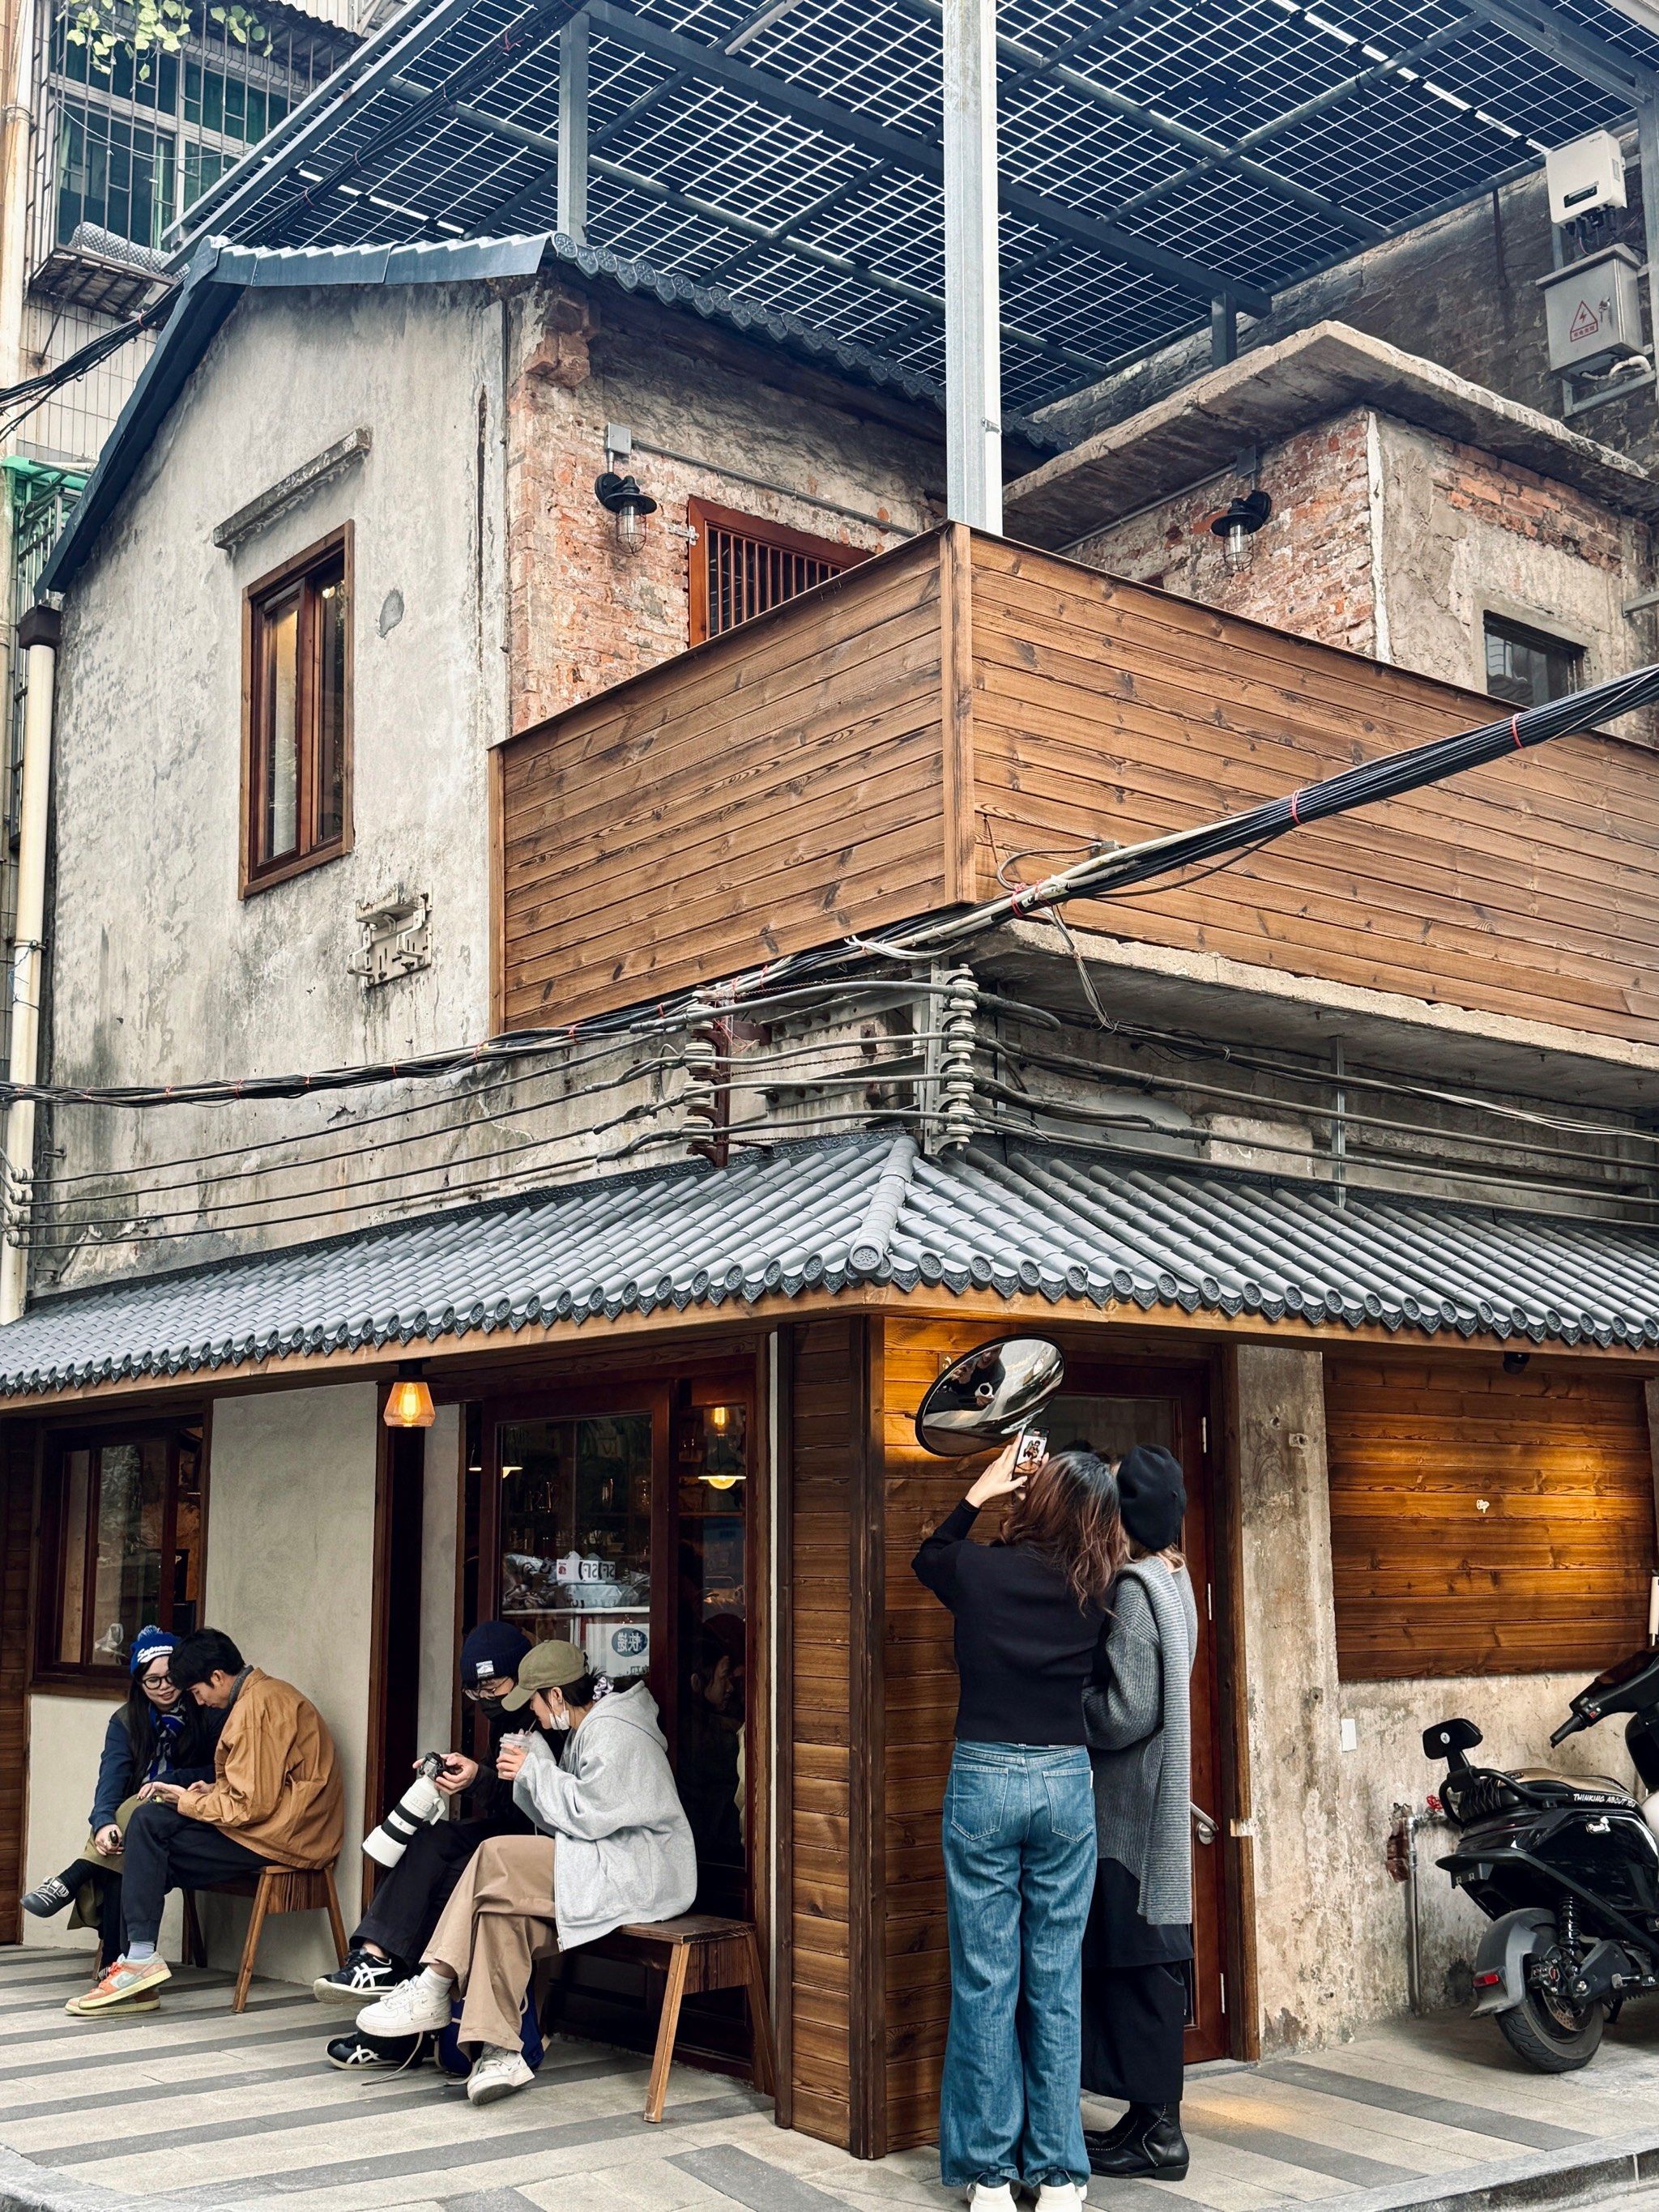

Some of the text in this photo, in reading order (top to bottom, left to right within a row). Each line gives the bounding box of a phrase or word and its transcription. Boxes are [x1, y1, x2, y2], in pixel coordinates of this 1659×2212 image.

[1573, 1793, 1636, 1808] THINKING ABOUT YOU
